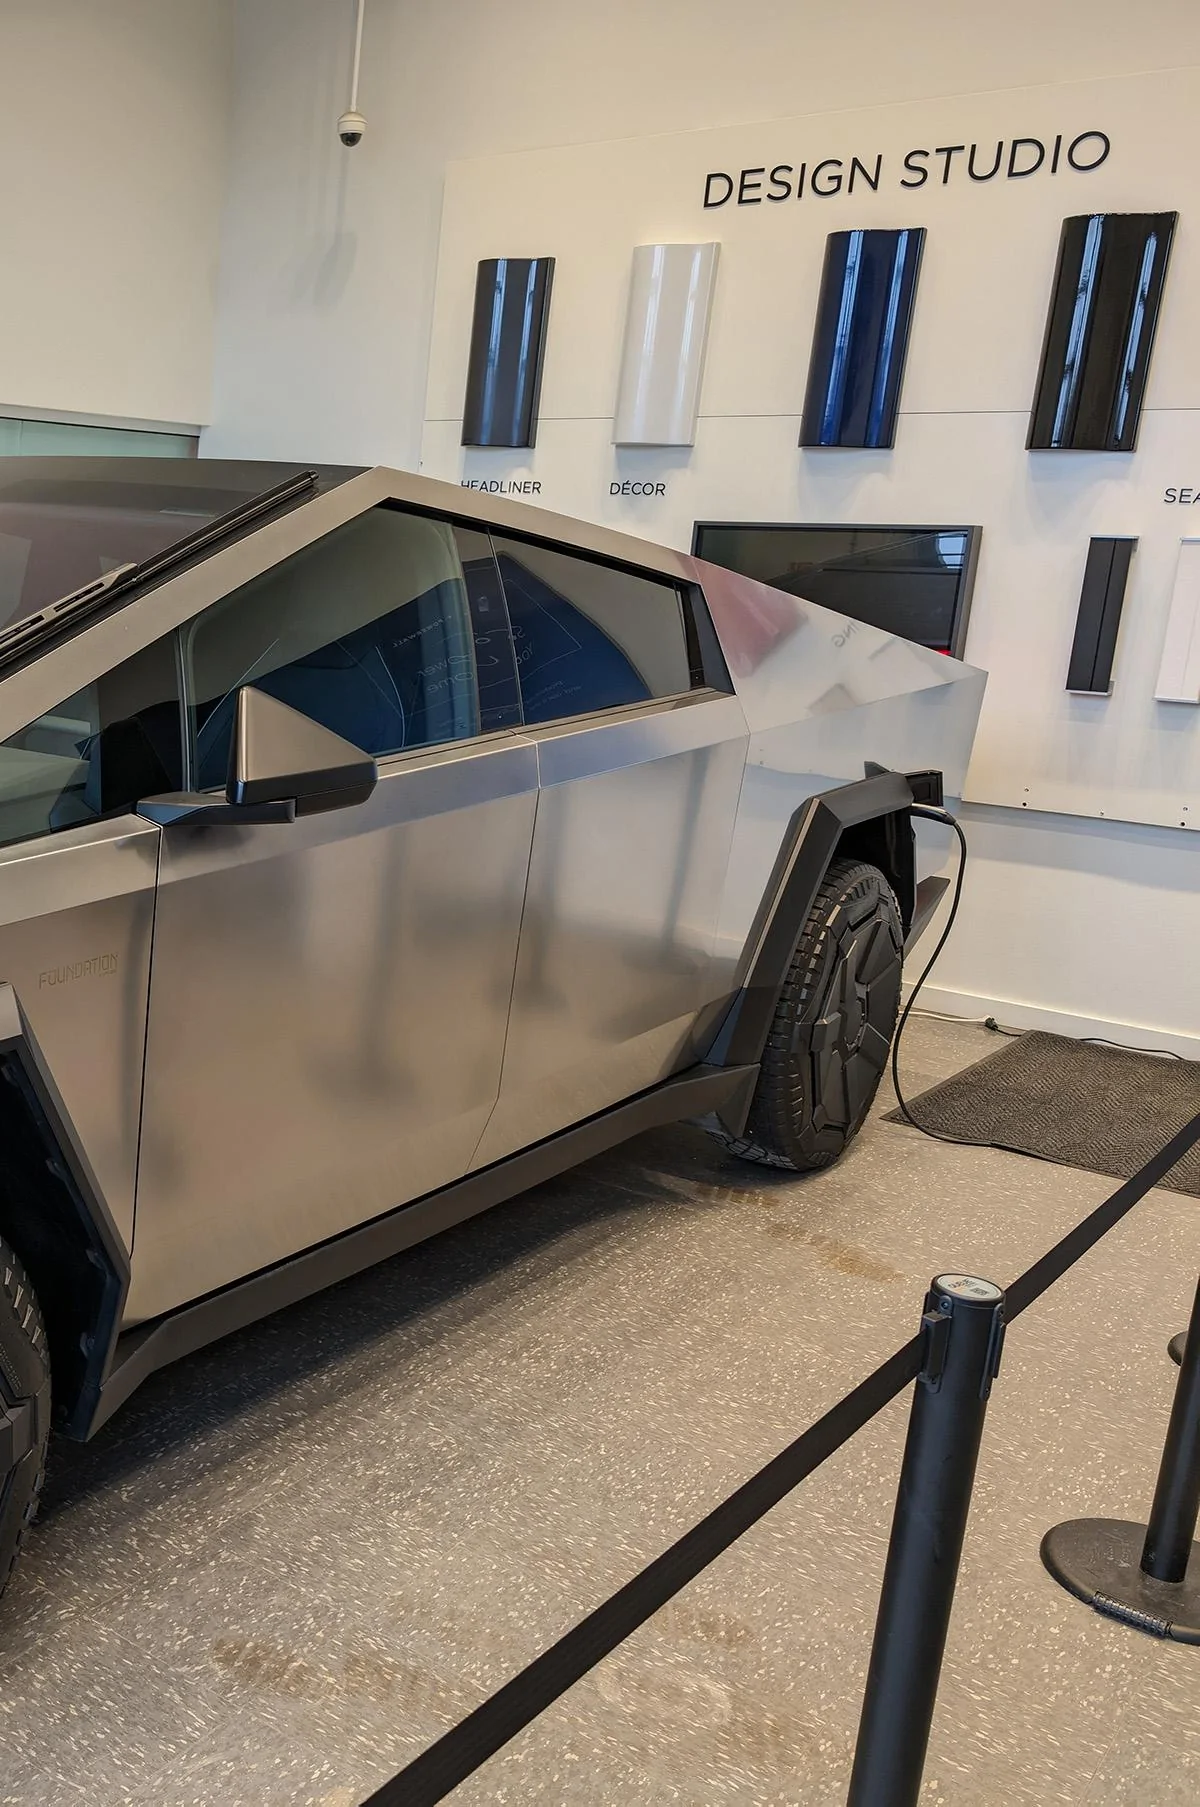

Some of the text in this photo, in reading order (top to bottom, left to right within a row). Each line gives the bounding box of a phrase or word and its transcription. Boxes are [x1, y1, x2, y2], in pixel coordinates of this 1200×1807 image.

[703, 131, 1111, 208] DESIGN STUDIO
[609, 480, 666, 496] DÉCOR
[38, 953, 118, 990] FOUNDATION
